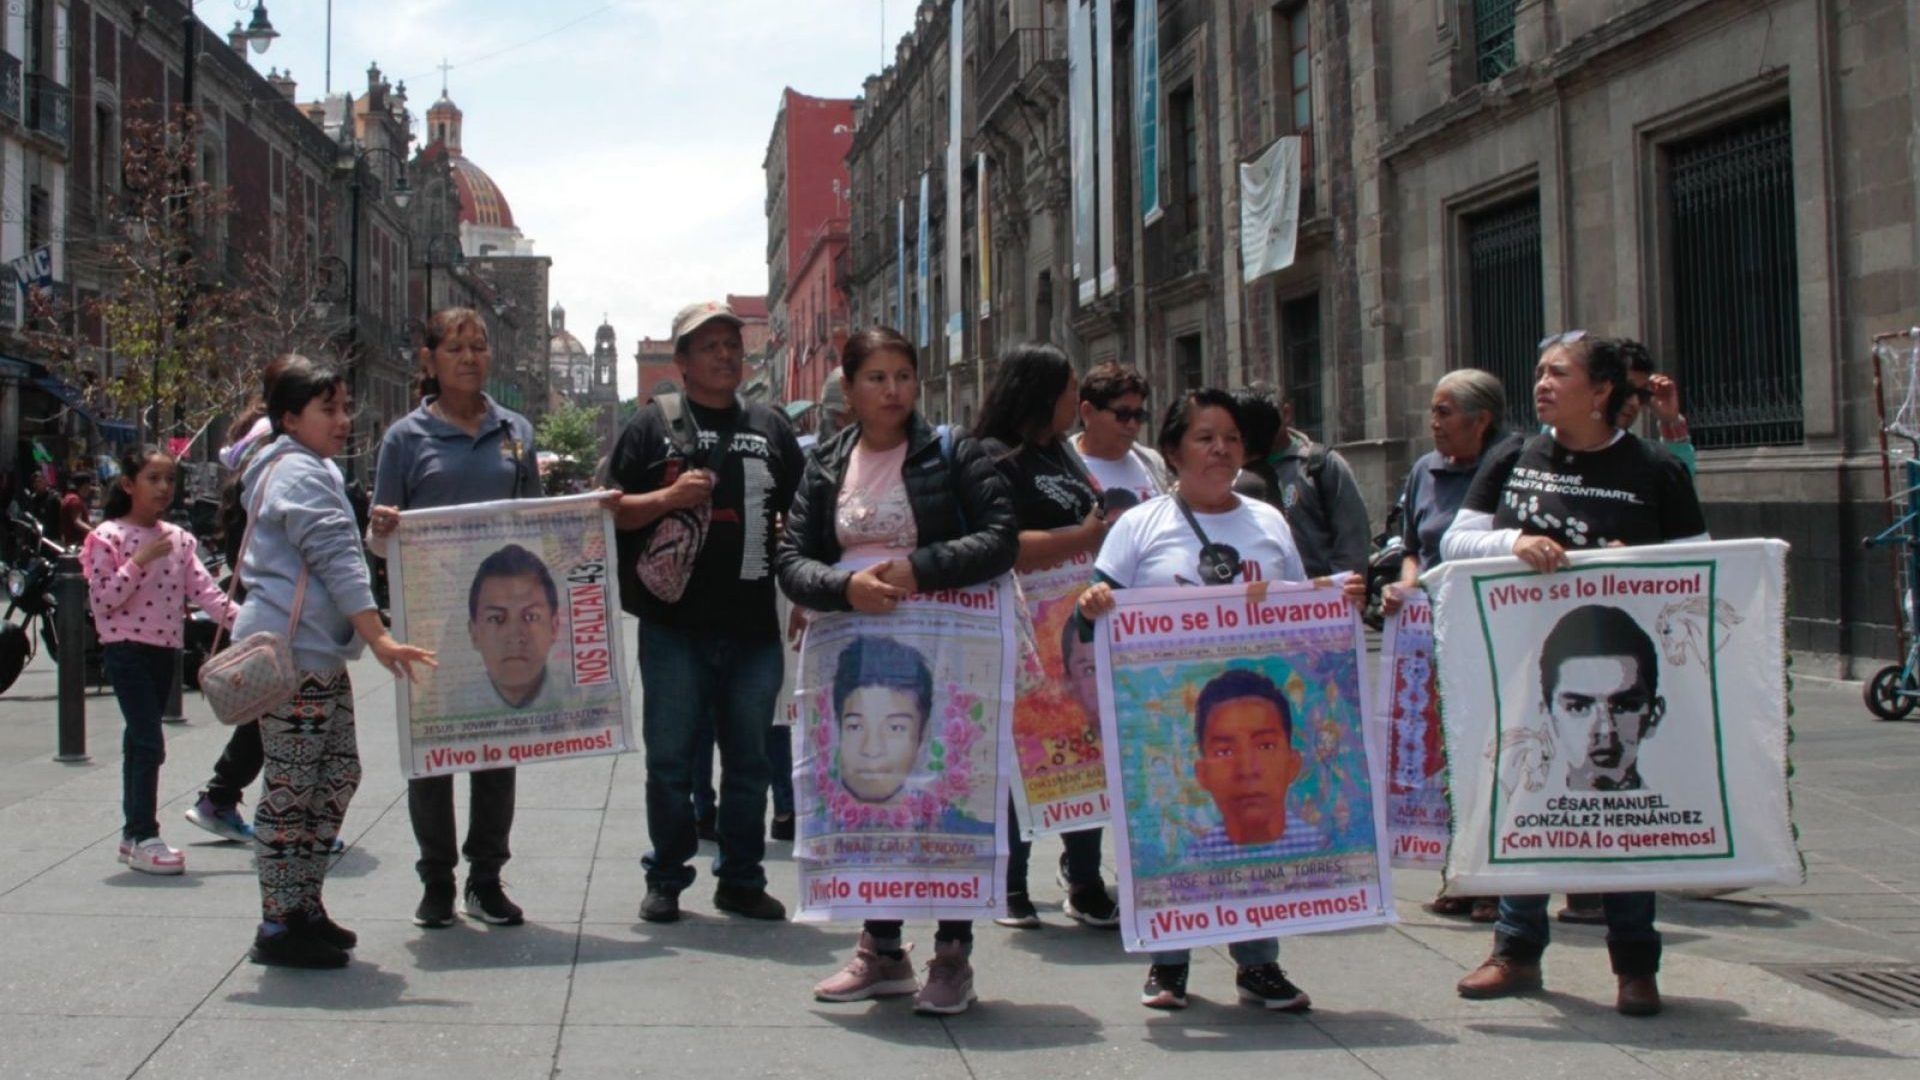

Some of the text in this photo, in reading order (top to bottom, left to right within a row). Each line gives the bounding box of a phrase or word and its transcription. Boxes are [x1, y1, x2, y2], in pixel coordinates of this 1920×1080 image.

[12, 249, 50, 283] WC
[1507, 478, 1544, 491] HASTA
[1549, 583, 1570, 600] se
[1576, 577, 1597, 598] lo
[1602, 573, 1701, 596] llevaron!
[572, 584, 606, 645] FALTAN
[1113, 596, 1350, 642] ¡Vivo se lo llevaron!
[576, 648, 609, 685] NOS
[425, 729, 613, 773] ¡Vivo lo queremos!
[1043, 801, 1094, 828] ¡Vivo
[1546, 795, 1669, 811] CÉSAR MANUEL
[1515, 811, 1703, 828] GONZÁLEZ HERNÁNDEZ
[1393, 834, 1442, 857] ¡Vivo
[1502, 827, 1716, 854] ¡Con VIDA lo queremos!
[1251, 865, 1286, 882] LUNA
[1294, 860, 1343, 877] TORRES
[858, 876, 979, 904] queremos!
[1150, 911, 1209, 940] ¡Vivo
[1216, 905, 1238, 926] lo
[1246, 889, 1369, 928] queremos!
